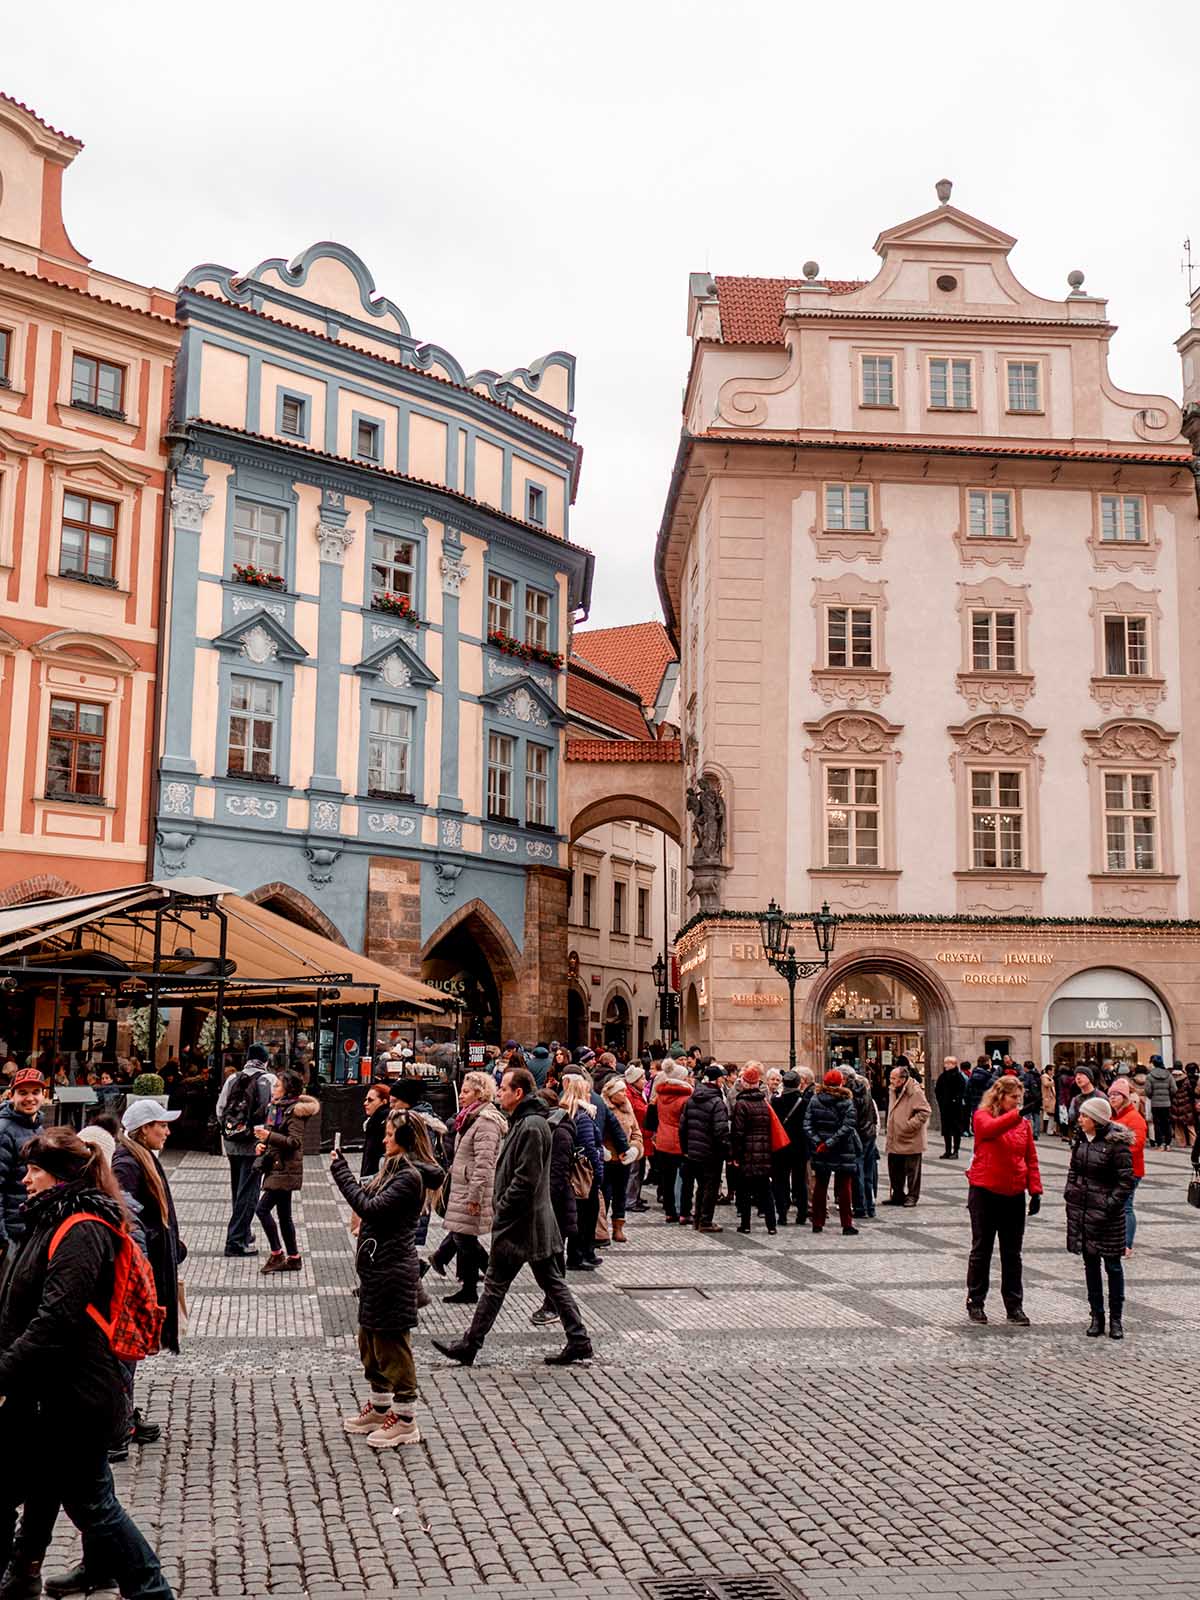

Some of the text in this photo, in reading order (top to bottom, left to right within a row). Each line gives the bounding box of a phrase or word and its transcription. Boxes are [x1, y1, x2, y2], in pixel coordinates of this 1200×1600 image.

[1004, 953, 1054, 965] JEWELRY
[963, 973, 1029, 985] PORCELAIN
[992, 1049, 1002, 1060] A
